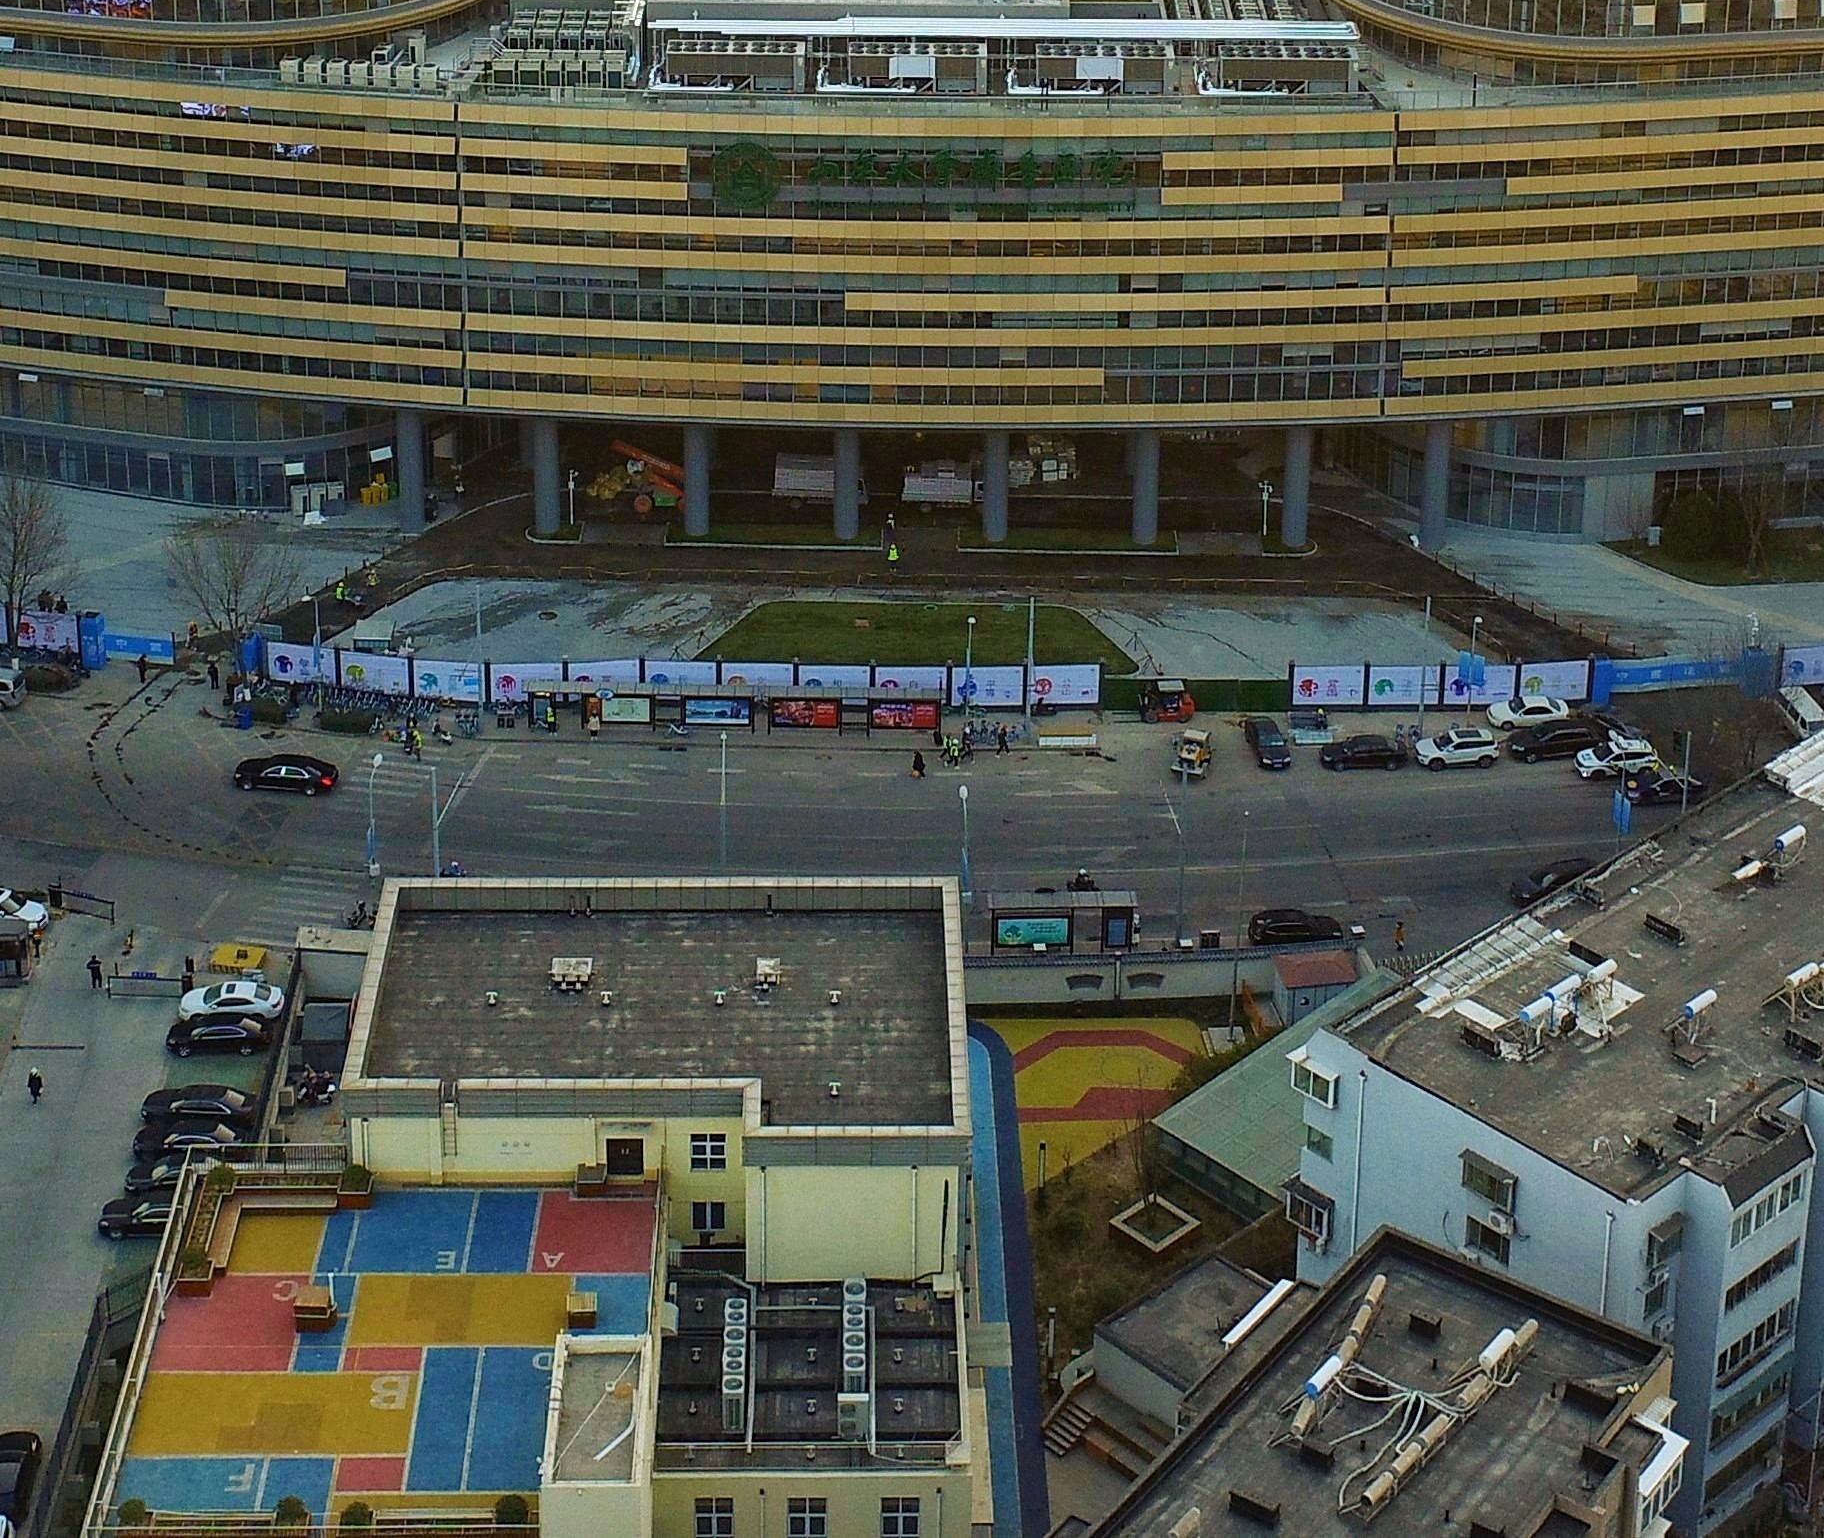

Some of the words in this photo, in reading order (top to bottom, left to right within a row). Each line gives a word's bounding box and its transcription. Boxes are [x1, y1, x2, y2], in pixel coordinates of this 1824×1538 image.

[435, 1250, 457, 1269] E
[541, 1252, 565, 1268] A
[271, 1279, 300, 1302] C
[369, 1374, 410, 1410] B
[223, 1463, 255, 1493] F
